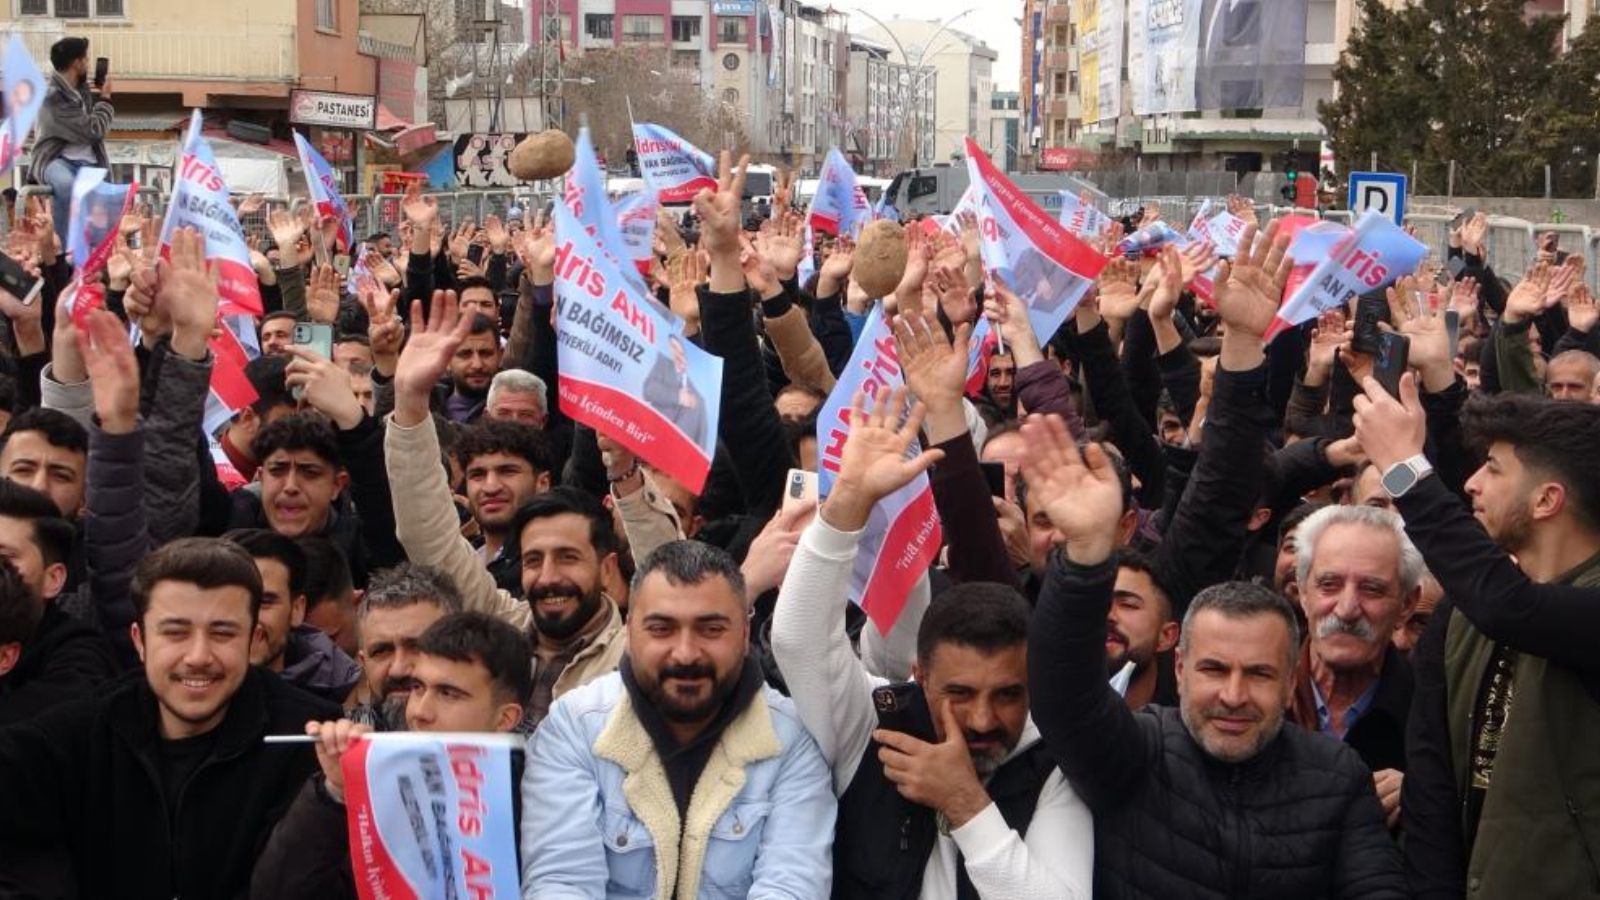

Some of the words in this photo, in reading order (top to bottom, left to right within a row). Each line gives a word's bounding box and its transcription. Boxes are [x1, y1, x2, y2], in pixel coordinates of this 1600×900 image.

[318, 101, 369, 118] PASTANESİ
[1365, 186, 1388, 214] D
[566, 300, 645, 364] BAĞIMSIZ
